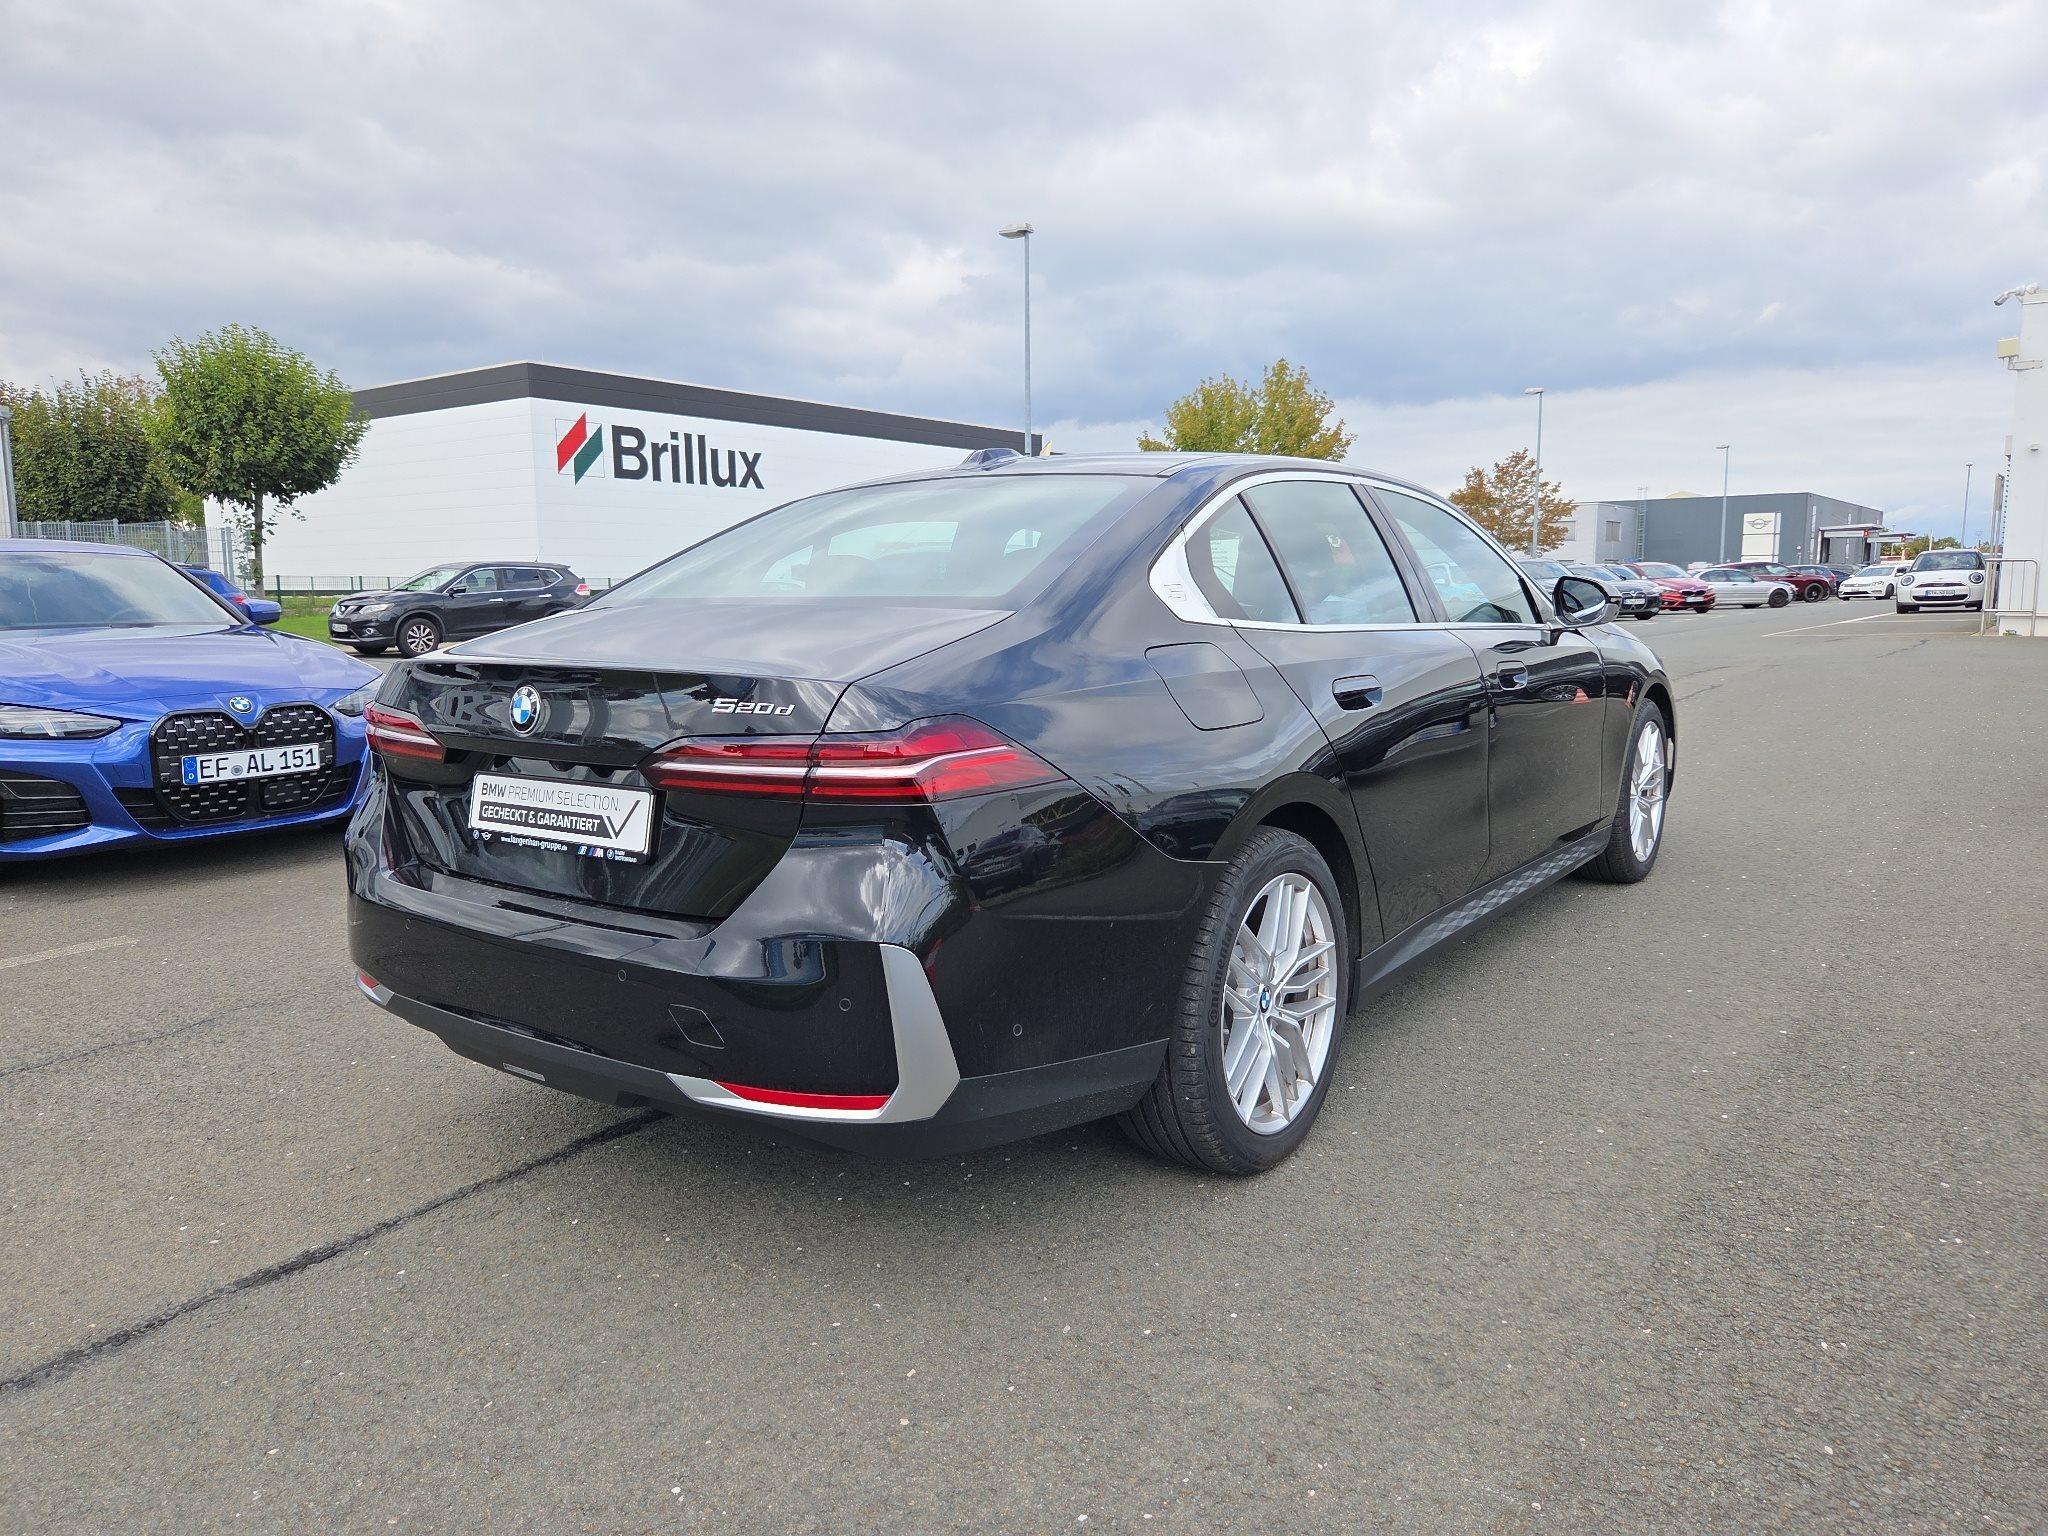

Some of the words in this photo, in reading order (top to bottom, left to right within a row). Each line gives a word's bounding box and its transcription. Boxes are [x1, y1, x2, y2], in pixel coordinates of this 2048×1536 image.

[611, 424, 765, 489] Brillux
[712, 697, 795, 716] 520d
[200, 757, 229, 779] EF
[246, 754, 274, 774] AL
[279, 748, 317, 770] 151
[481, 782, 507, 798] BMW
[507, 785, 554, 804] PREMIUM
[557, 790, 621, 812] SELECTION.
[482, 804, 527, 823] GECHECKT
[528, 810, 536, 824] &
[537, 812, 600, 832] GARANTIERT
